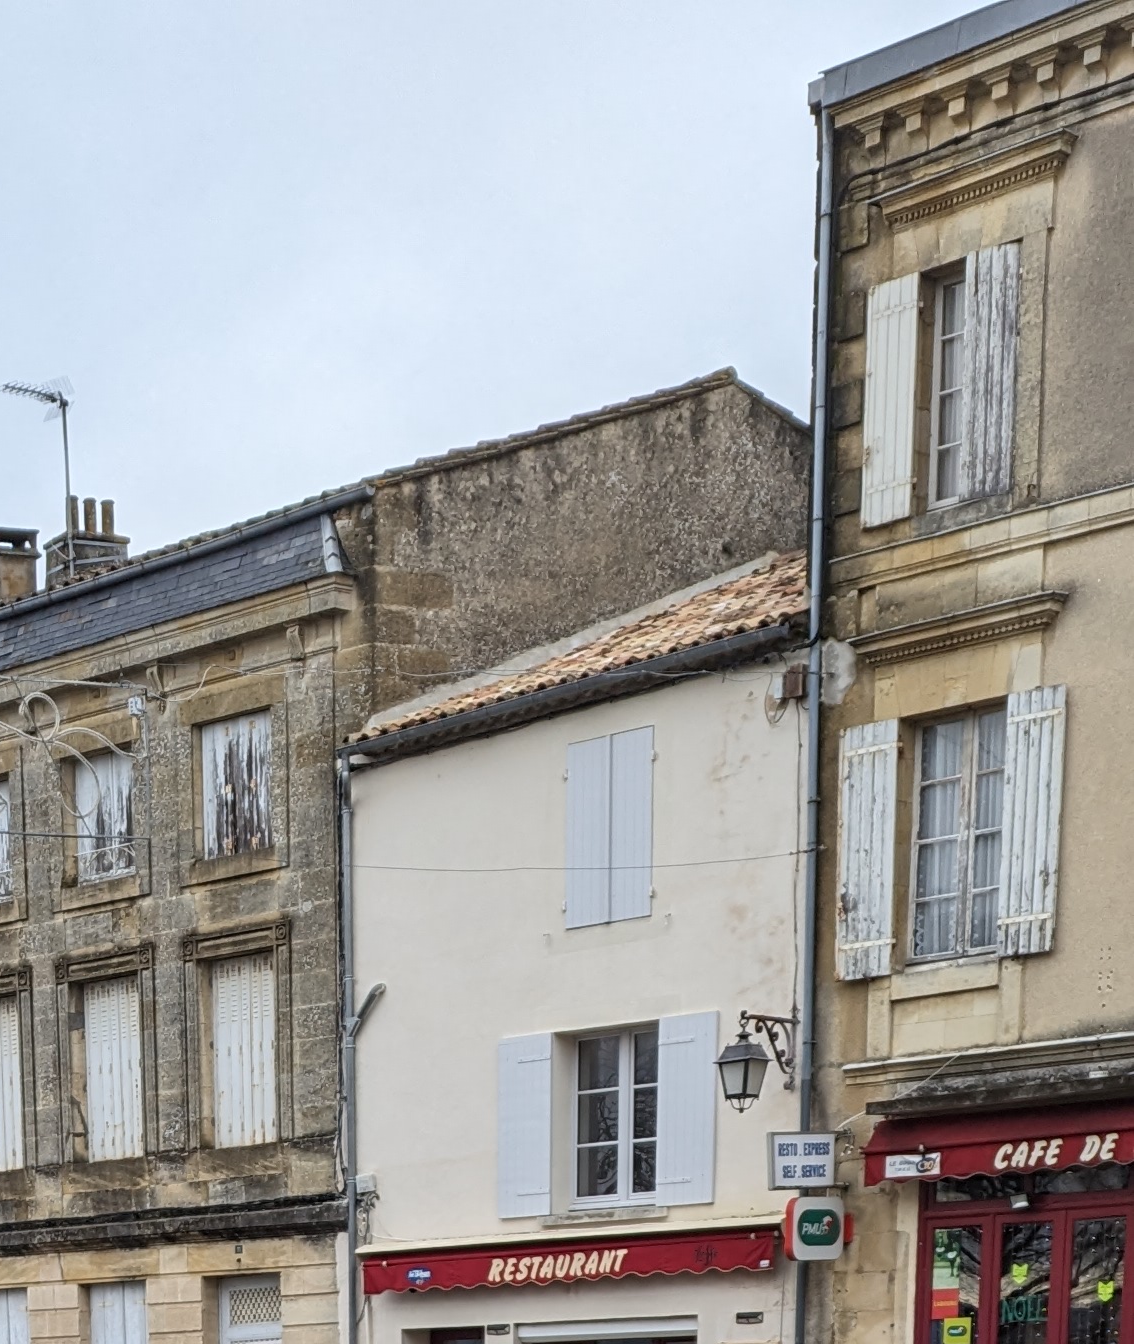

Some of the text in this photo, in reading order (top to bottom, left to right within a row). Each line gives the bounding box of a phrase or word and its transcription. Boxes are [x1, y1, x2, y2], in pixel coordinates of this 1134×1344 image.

[778, 1142, 798, 1157] RESTO
[803, 1141, 831, 1156] EXPRESS
[994, 1132, 1120, 1170] CAFE DE
[782, 1164, 797, 1179] SELF
[801, 1164, 826, 1178] SERVICE
[802, 1221, 823, 1235] PMU
[488, 1249, 628, 1283] RESTAURANT
